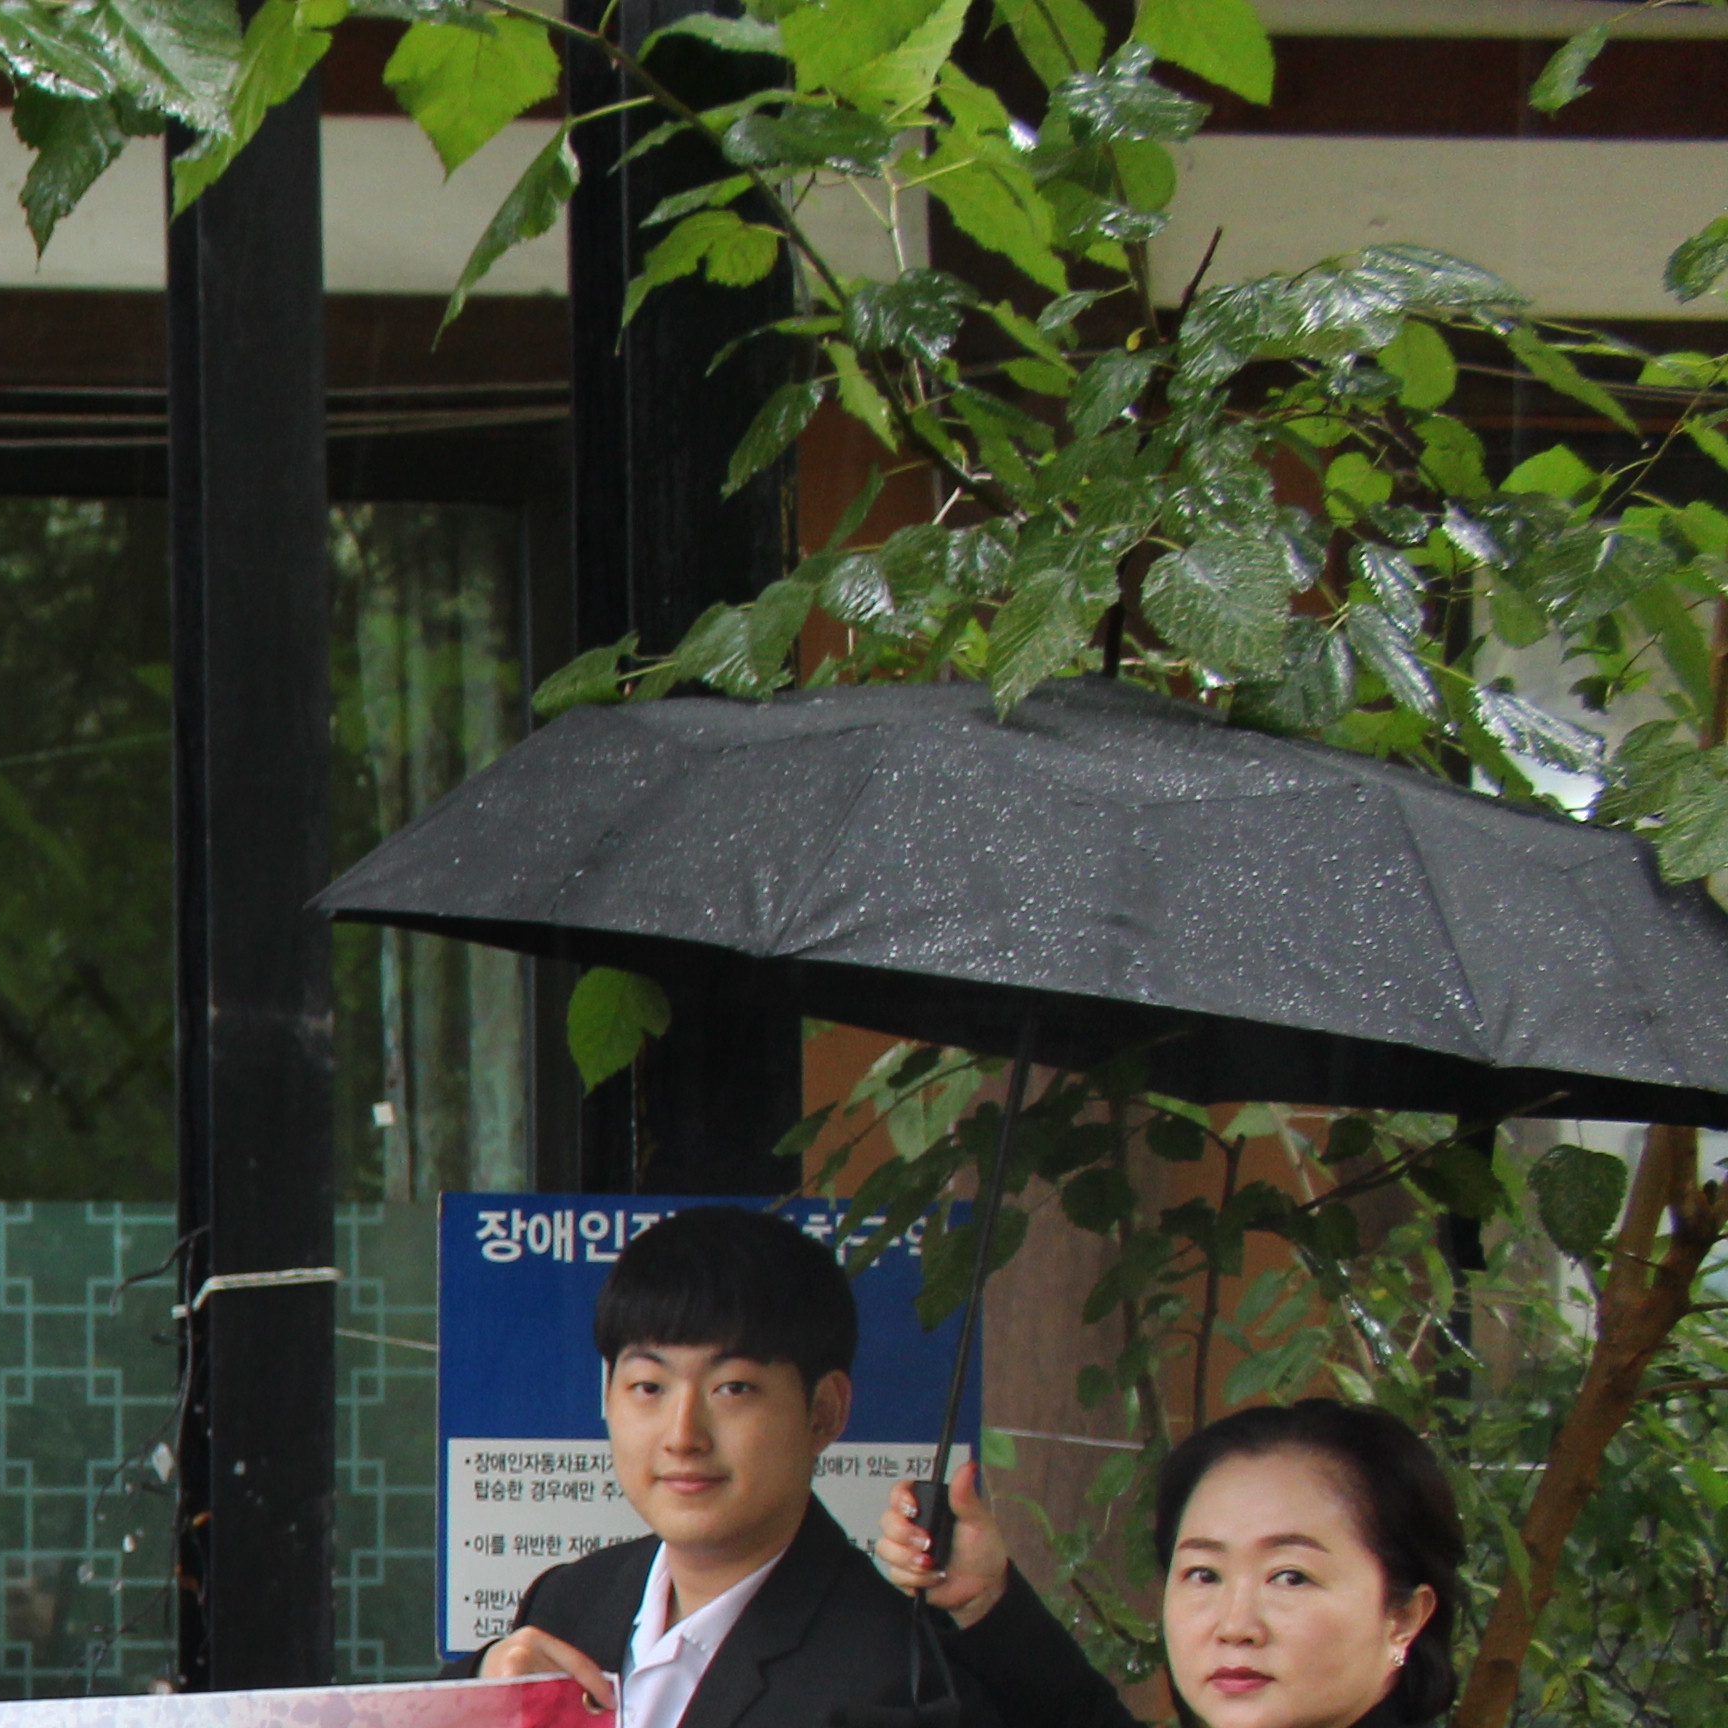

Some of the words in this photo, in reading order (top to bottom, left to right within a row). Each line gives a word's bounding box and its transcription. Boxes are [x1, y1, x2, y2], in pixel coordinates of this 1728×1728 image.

[866, 1456, 899, 1477] 있는
[474, 1480, 523, 1500] 탑승한
[531, 1480, 594, 1500] 경우에만
[474, 1534, 505, 1555] 이를
[514, 1535, 561, 1555] 위반한
